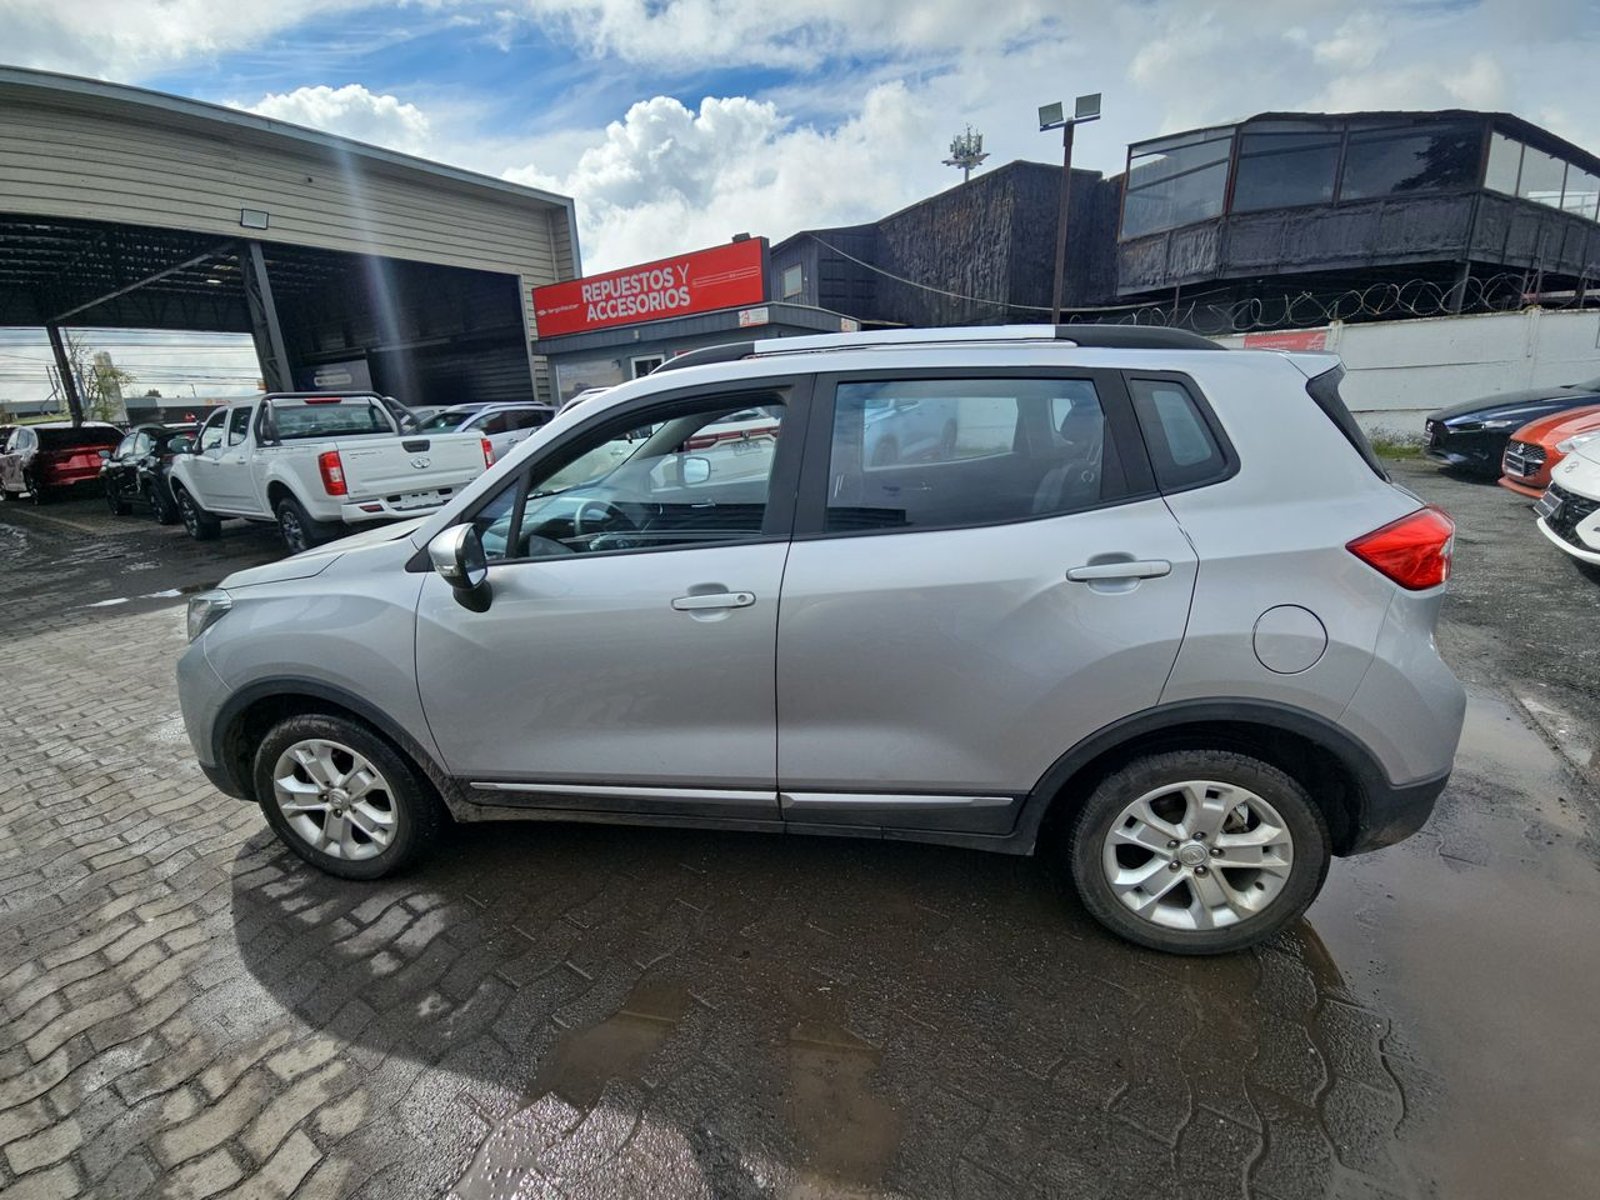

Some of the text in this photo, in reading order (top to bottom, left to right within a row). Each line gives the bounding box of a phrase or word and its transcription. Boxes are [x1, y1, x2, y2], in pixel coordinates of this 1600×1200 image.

[582, 263, 689, 303] REPUESTOS Y
[586, 286, 690, 322] ACCESORIOS
